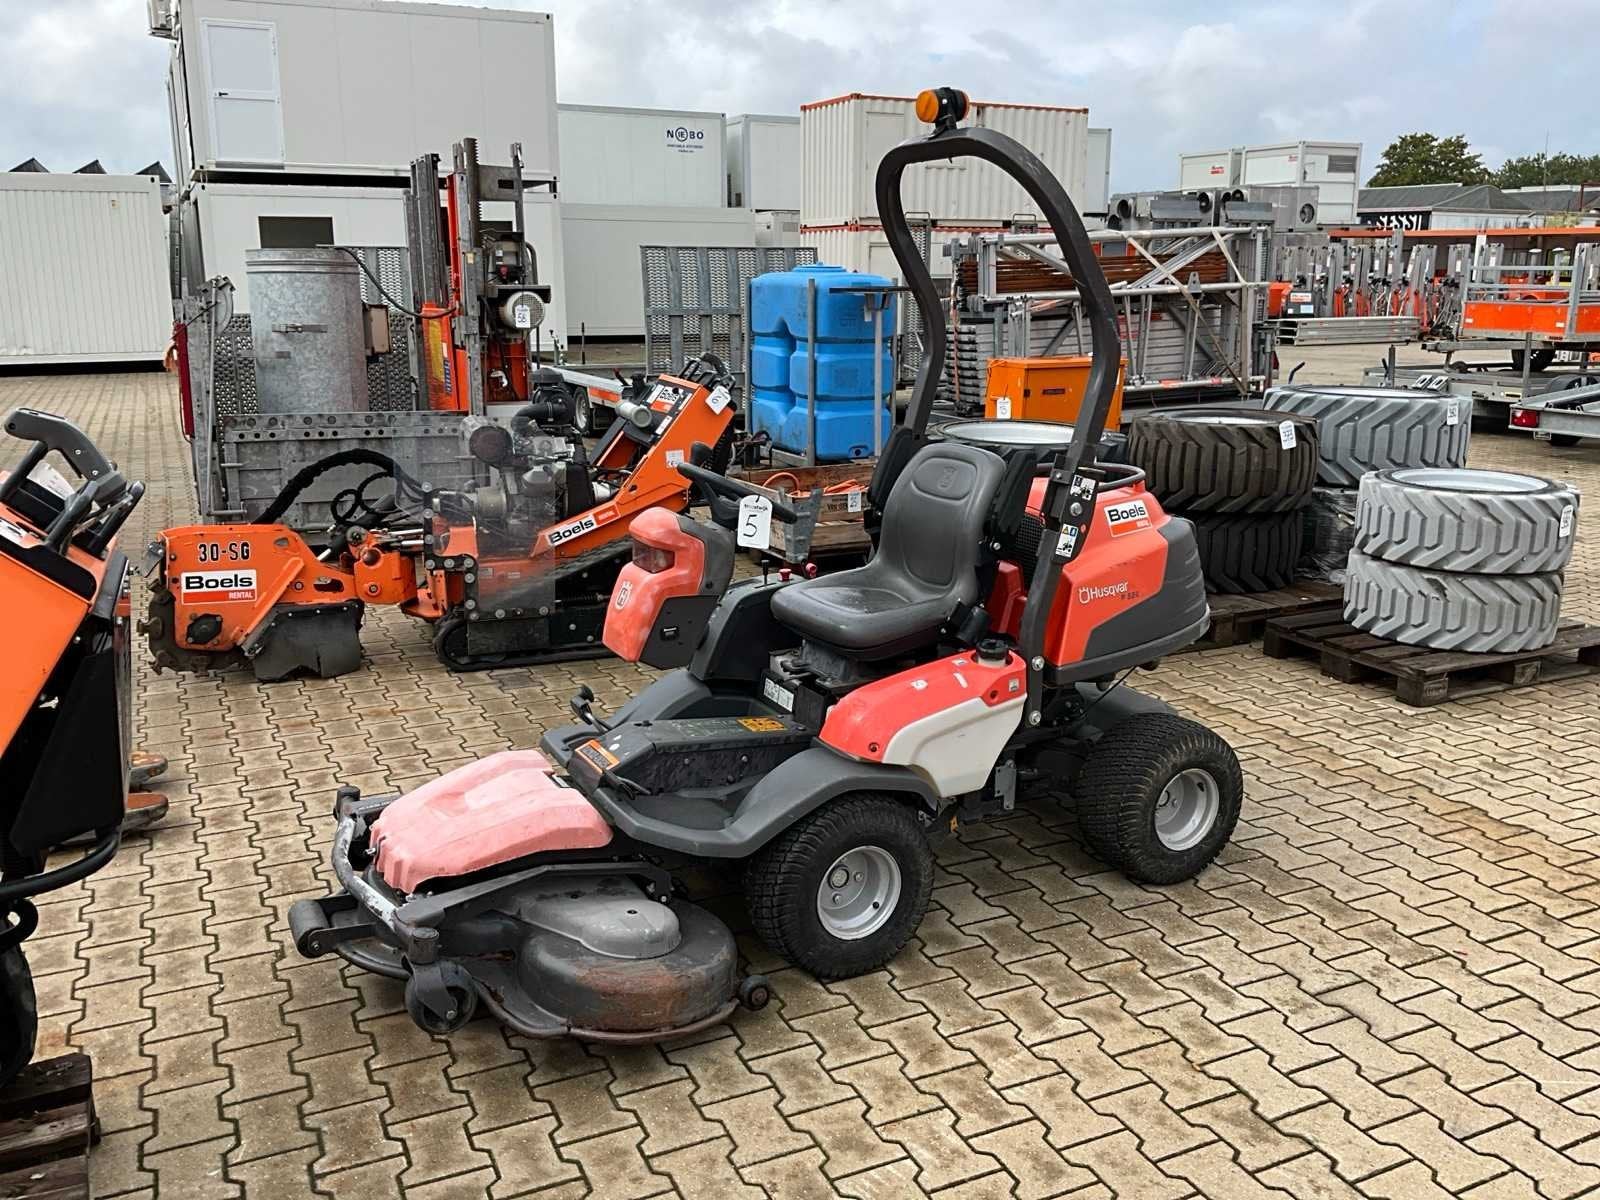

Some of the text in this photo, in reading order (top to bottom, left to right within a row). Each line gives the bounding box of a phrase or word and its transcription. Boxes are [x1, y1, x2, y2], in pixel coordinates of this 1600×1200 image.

[1107, 505, 1145, 522] Boels
[549, 519, 594, 544] Boels
[743, 514, 757, 537] 5
[199, 542, 250, 562] 30-SG
[185, 573, 253, 590] Boels
[228, 592, 253, 600] RENTAL
